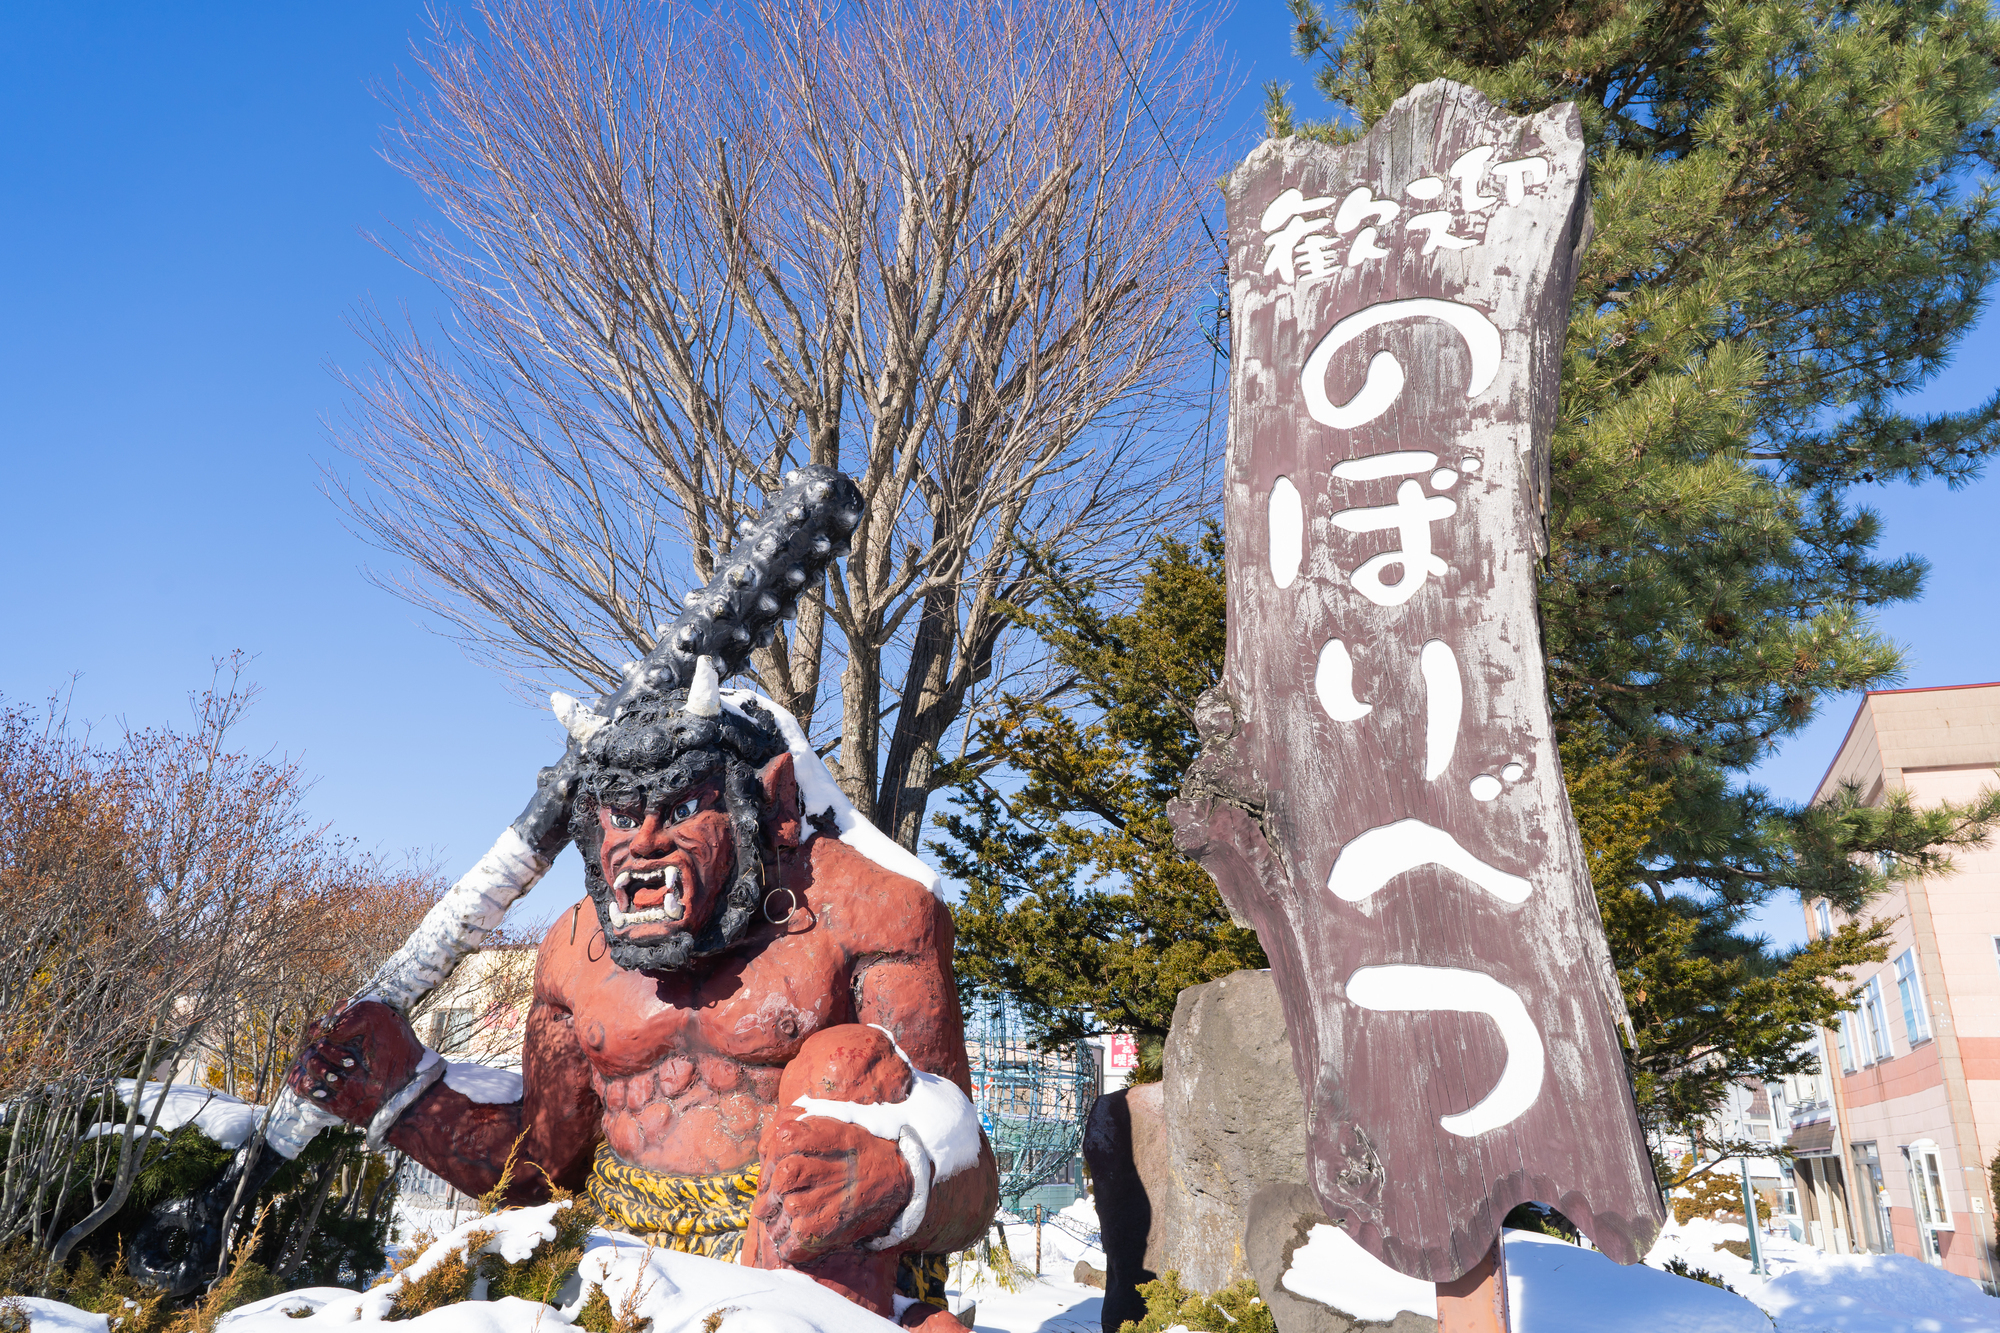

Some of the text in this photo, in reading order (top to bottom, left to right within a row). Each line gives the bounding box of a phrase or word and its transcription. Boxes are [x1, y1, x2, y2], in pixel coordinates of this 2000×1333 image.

[1260, 145, 1549, 284] 歓迎
[1267, 300, 1546, 1138] のぼりべつ
[1121, 1045, 1132, 1054] &
